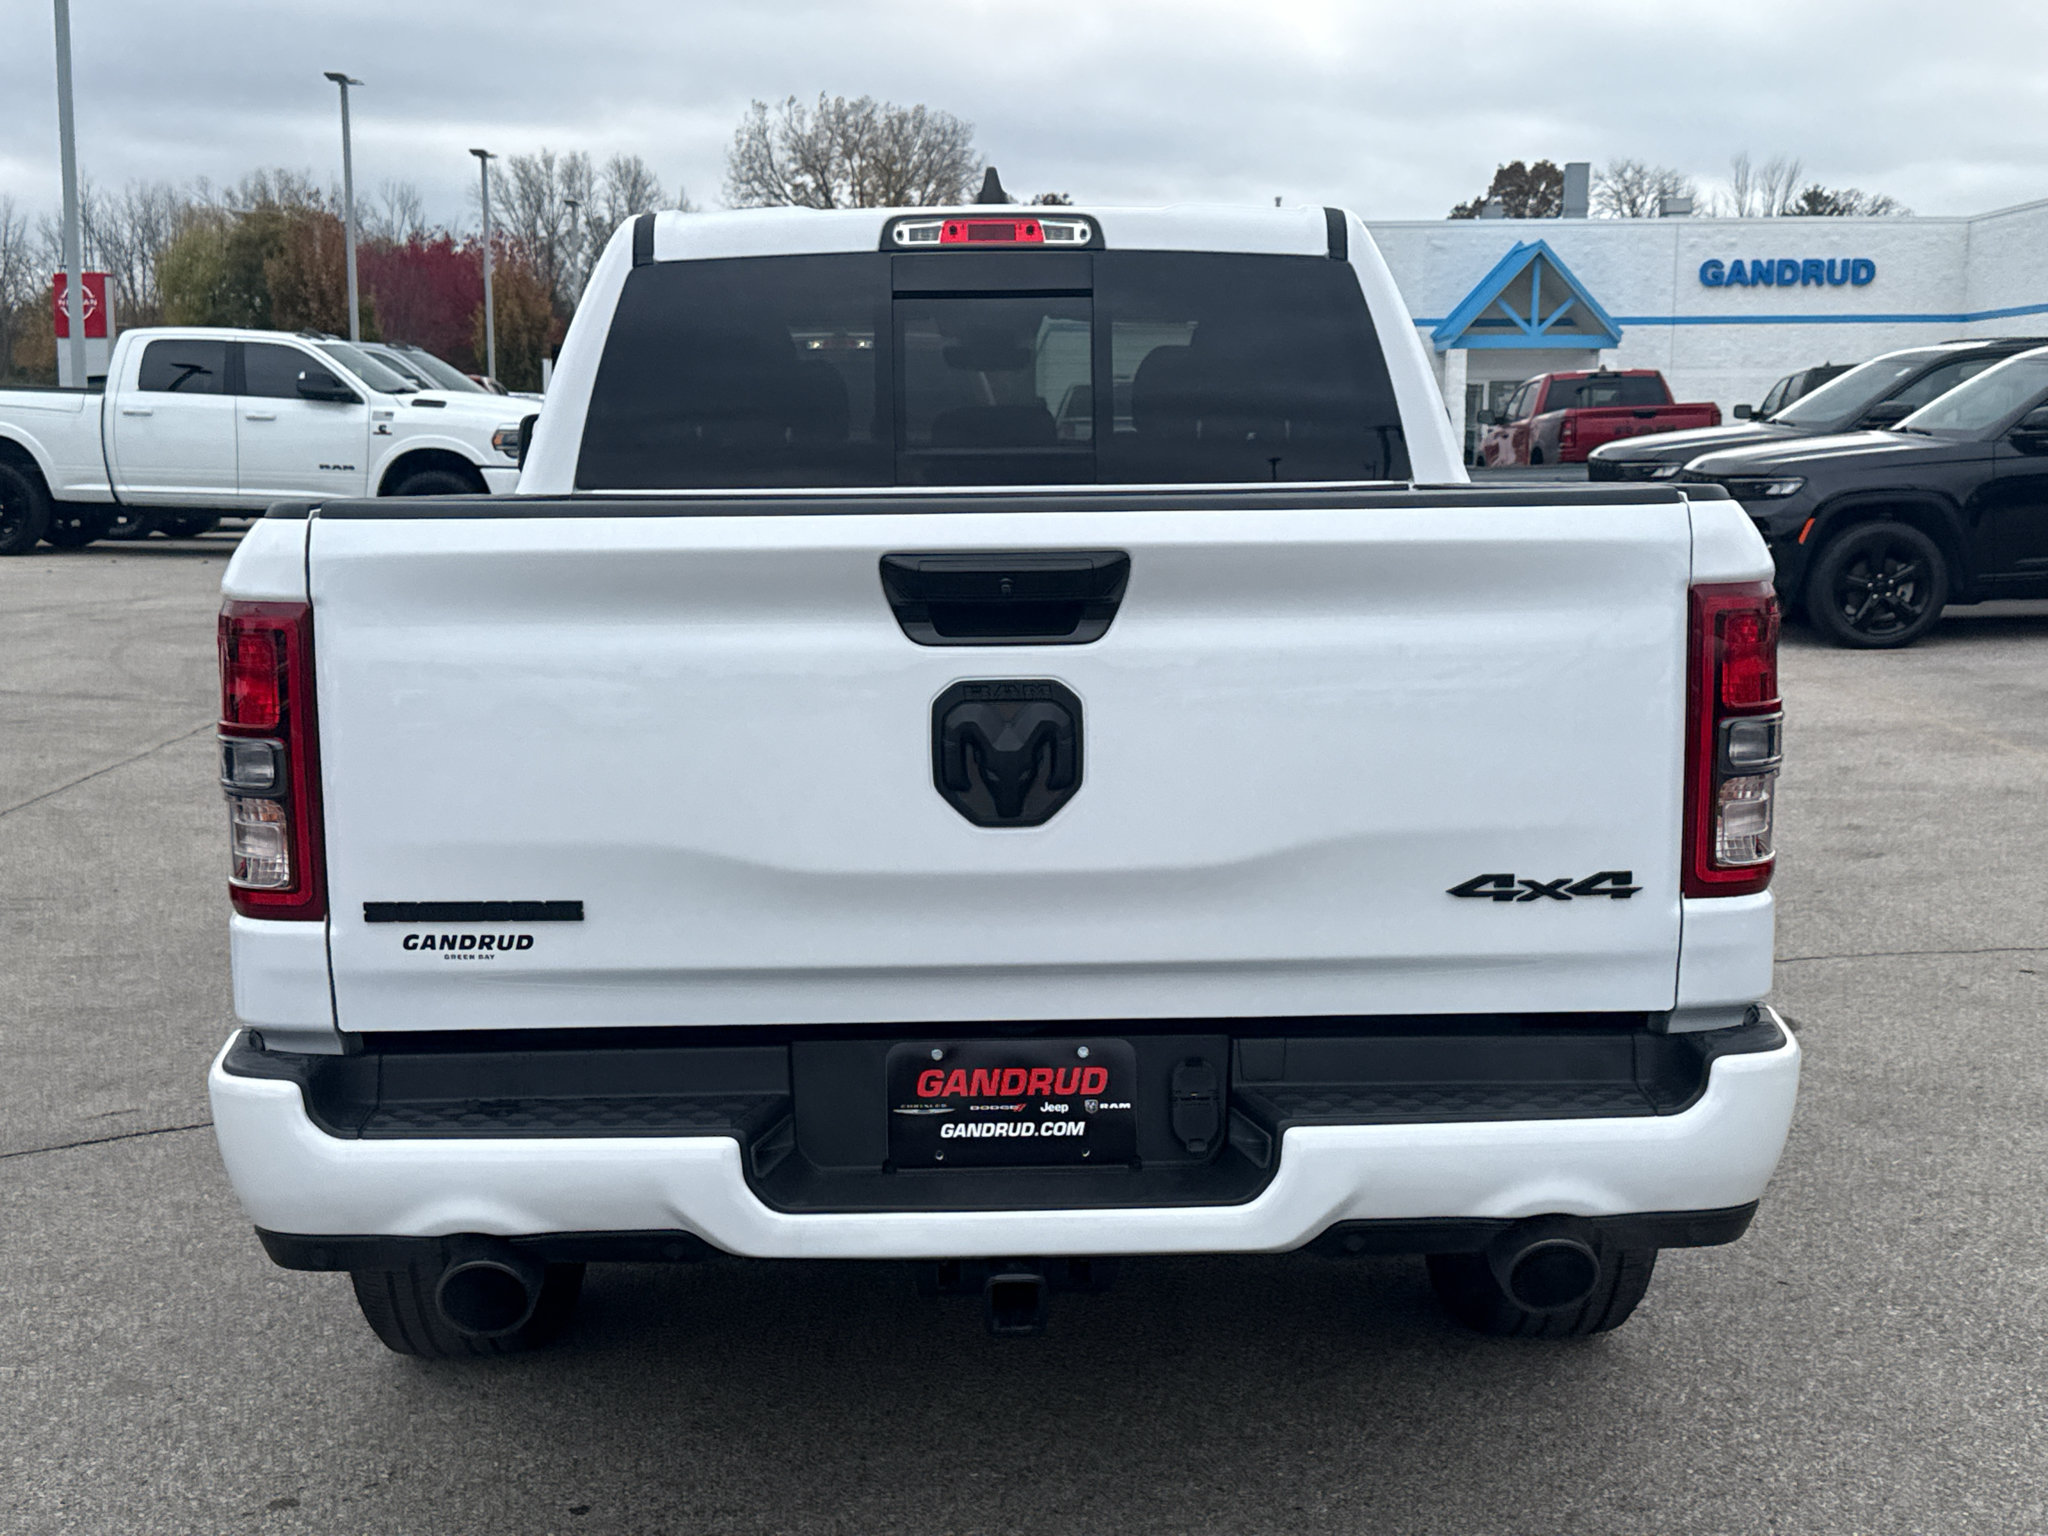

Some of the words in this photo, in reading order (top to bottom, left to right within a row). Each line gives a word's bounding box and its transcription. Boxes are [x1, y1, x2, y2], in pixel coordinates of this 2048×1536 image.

[1699, 258, 1876, 287] GANDRUD
[963, 684, 1052, 699] RAM
[1446, 871, 1643, 902] 4x4
[403, 934, 534, 951] GANDRUD
[917, 1067, 1109, 1098] GANDRUD
[1040, 1102, 1069, 1114] Jeep
[1100, 1102, 1131, 1110] RAM
[940, 1121, 1086, 1138] GANDRUD.COM
